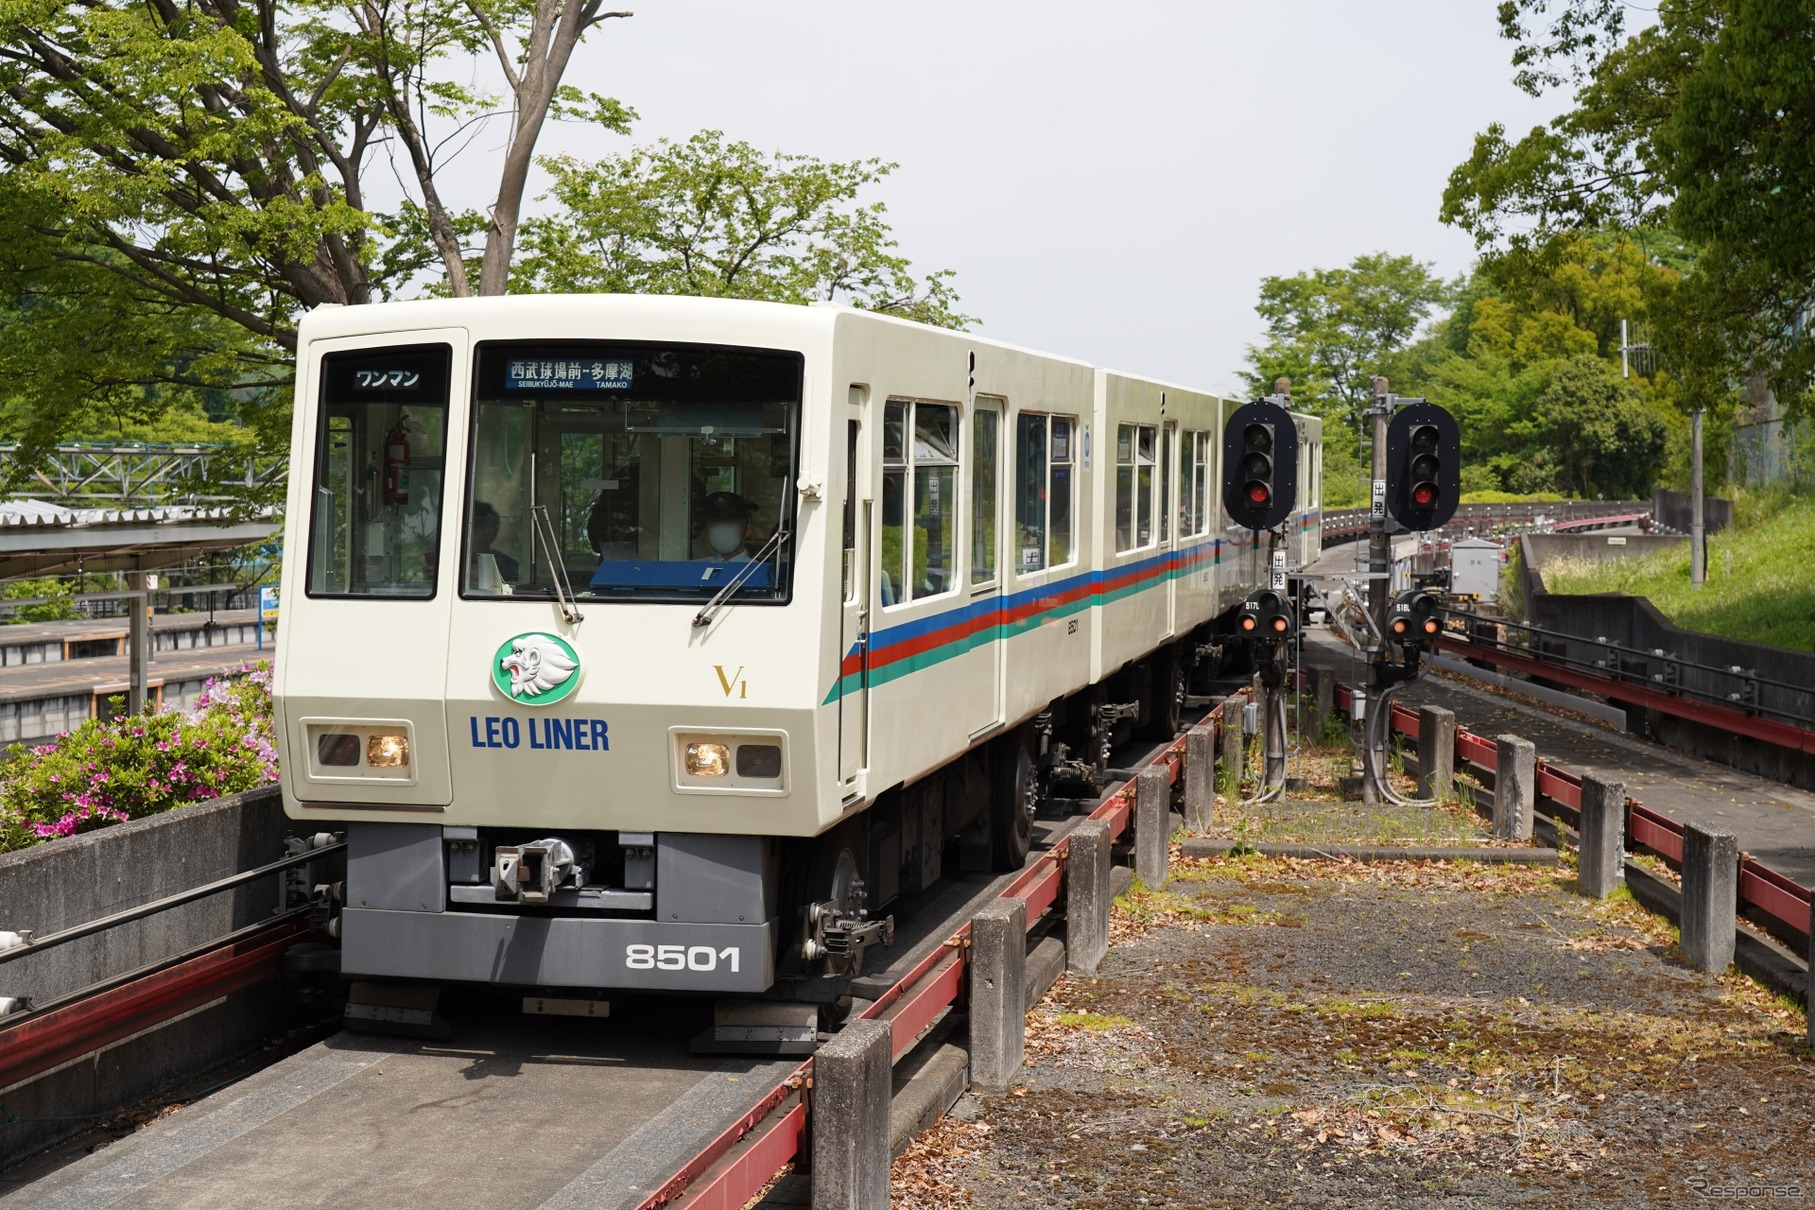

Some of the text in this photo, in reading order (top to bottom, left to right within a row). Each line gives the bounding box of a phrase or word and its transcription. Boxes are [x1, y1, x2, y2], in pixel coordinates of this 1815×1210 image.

[356, 370, 420, 388] ワンマン
[595, 381, 628, 389] TAMAKO
[1374, 483, 1384, 514] 出発
[470, 716, 610, 751] LEO LINER
[625, 944, 740, 973] 8501
